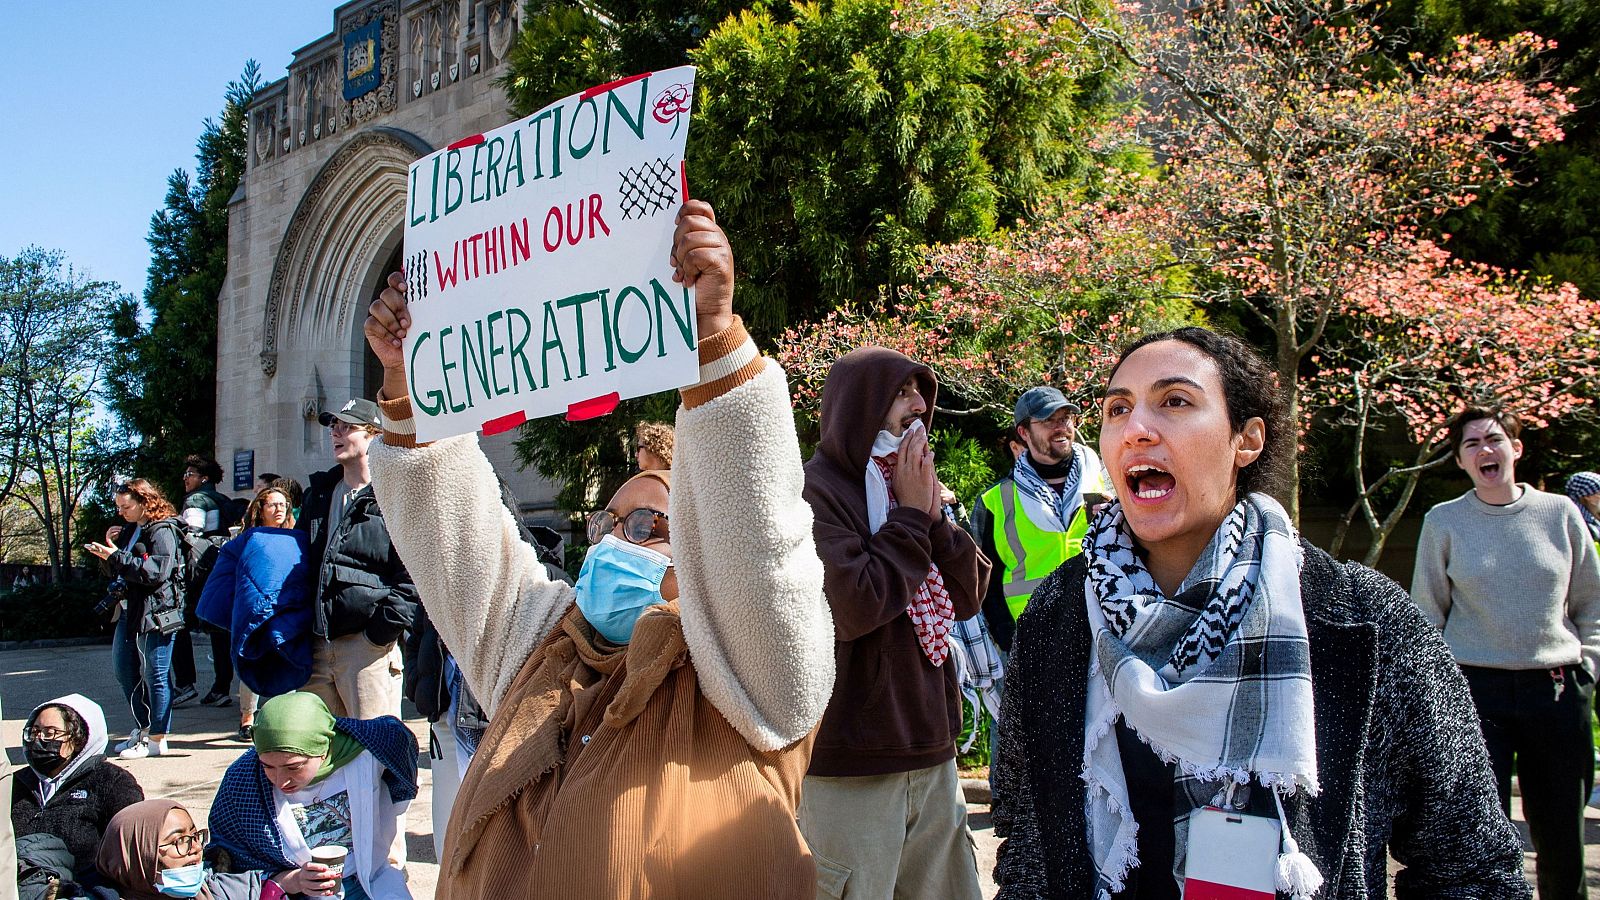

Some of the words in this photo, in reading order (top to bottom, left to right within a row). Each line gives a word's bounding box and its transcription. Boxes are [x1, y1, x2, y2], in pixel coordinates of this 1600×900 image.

[410, 77, 649, 227] LIBERATION
[434, 217, 531, 292] WITHIN
[543, 193, 611, 252] OUR
[410, 278, 697, 416] GENERATION
